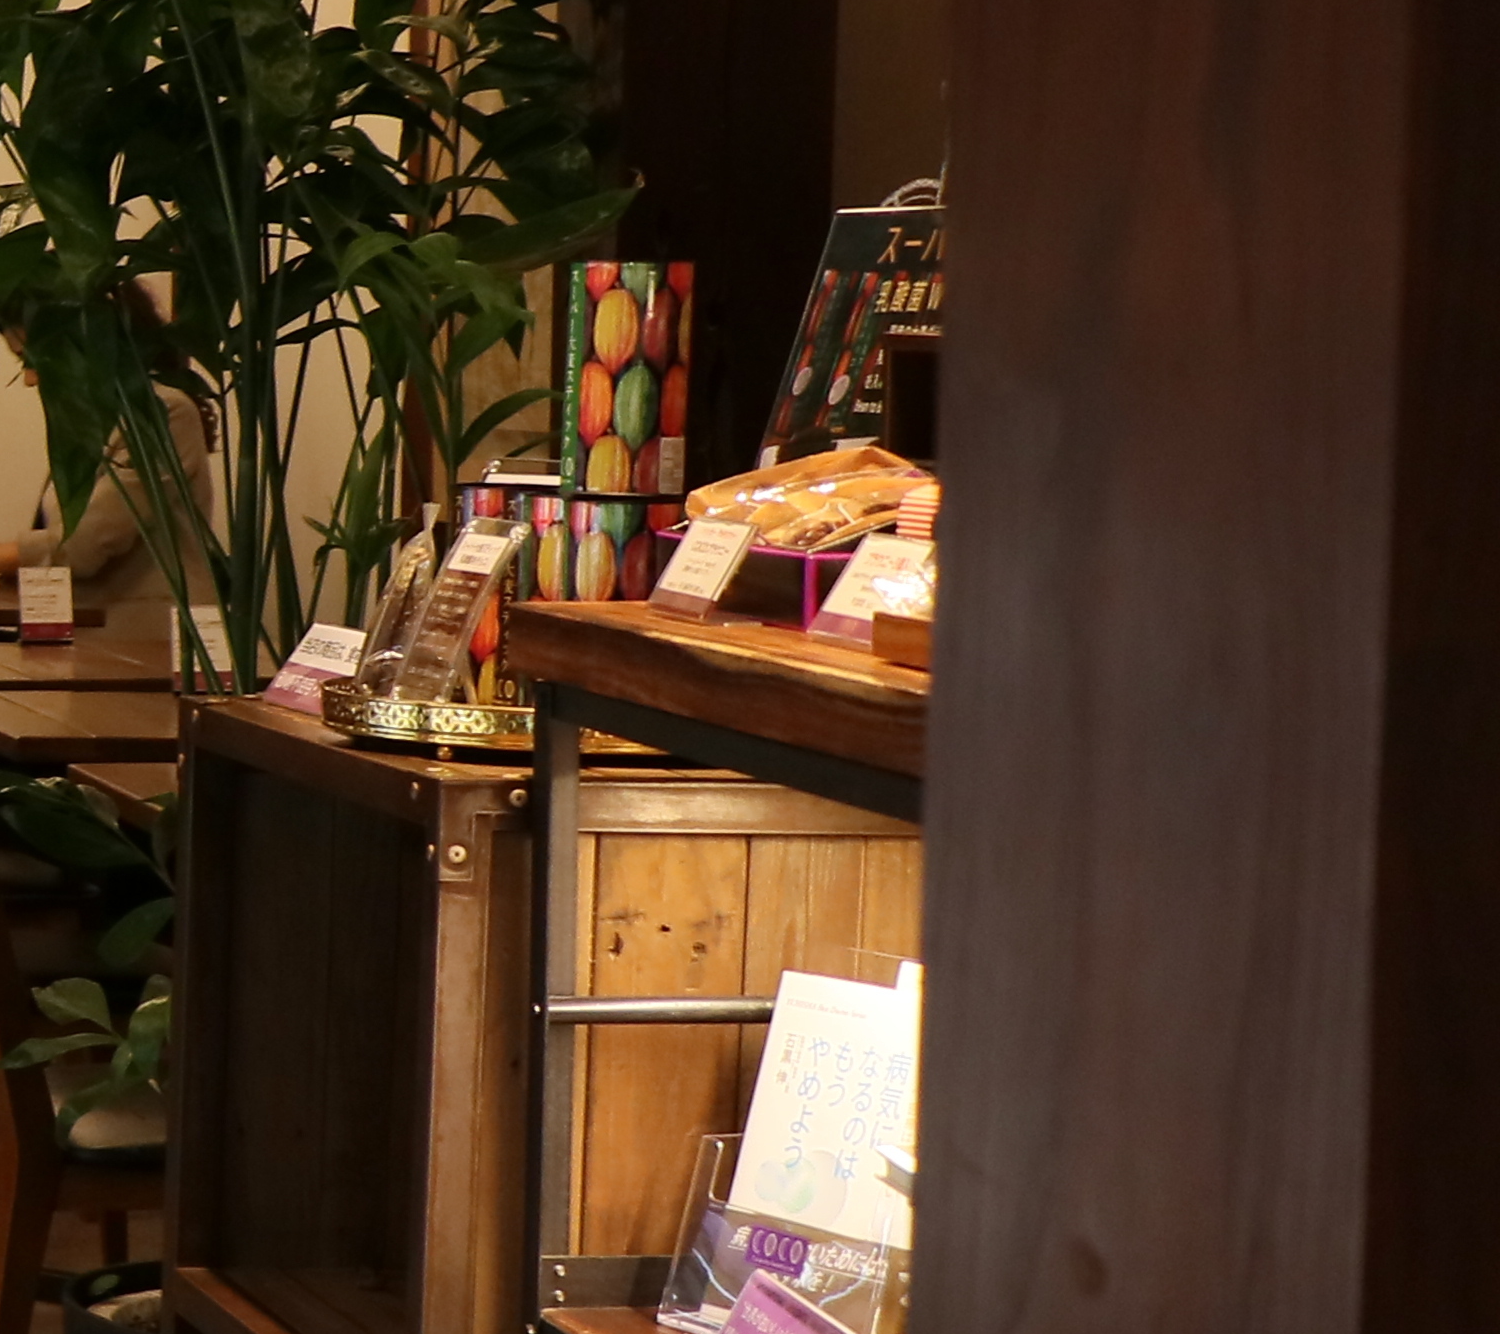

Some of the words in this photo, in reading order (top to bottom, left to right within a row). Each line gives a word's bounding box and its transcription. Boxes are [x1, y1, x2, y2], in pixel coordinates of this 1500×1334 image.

[784, 1035, 832, 1169] やめよう
[826, 1040, 854, 1108] もう
[833, 1045, 883, 1180] なるのは
[869, 1051, 912, 1150] 病気に
[752, 1229, 805, 1265] COCO
